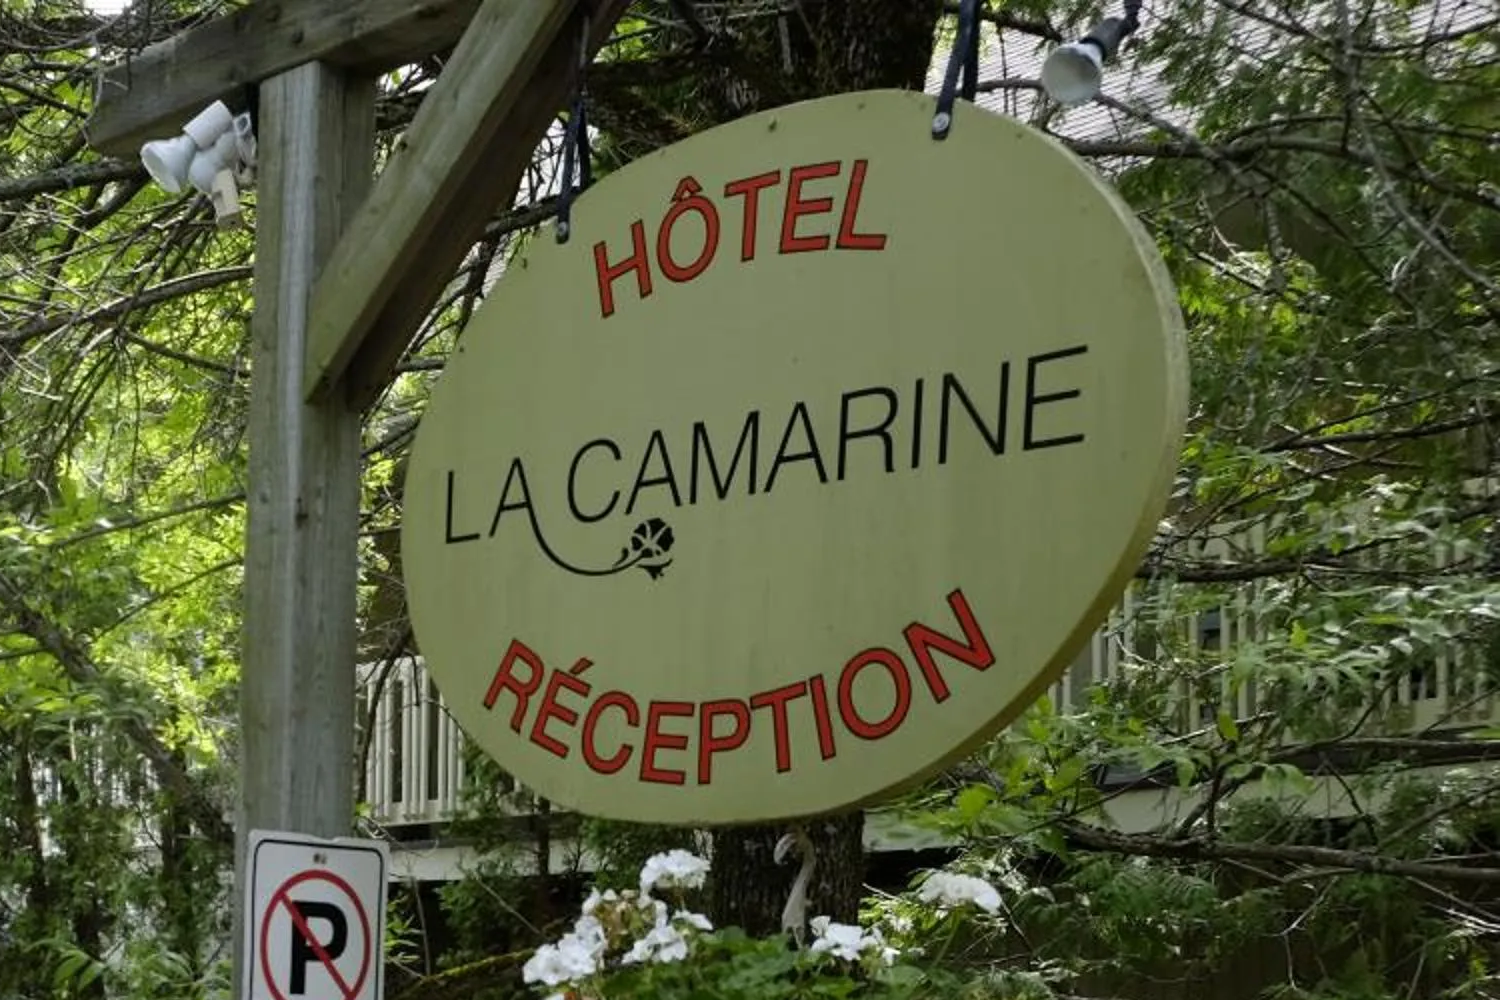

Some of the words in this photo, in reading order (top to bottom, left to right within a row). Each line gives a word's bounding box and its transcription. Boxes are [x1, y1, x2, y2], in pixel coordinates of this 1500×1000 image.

[592, 159, 888, 319] HÔTEL
[444, 457, 542, 548] LA
[566, 344, 1089, 523] CAMARINE
[483, 587, 997, 786] RÉCEPTION
[289, 900, 348, 994] P
